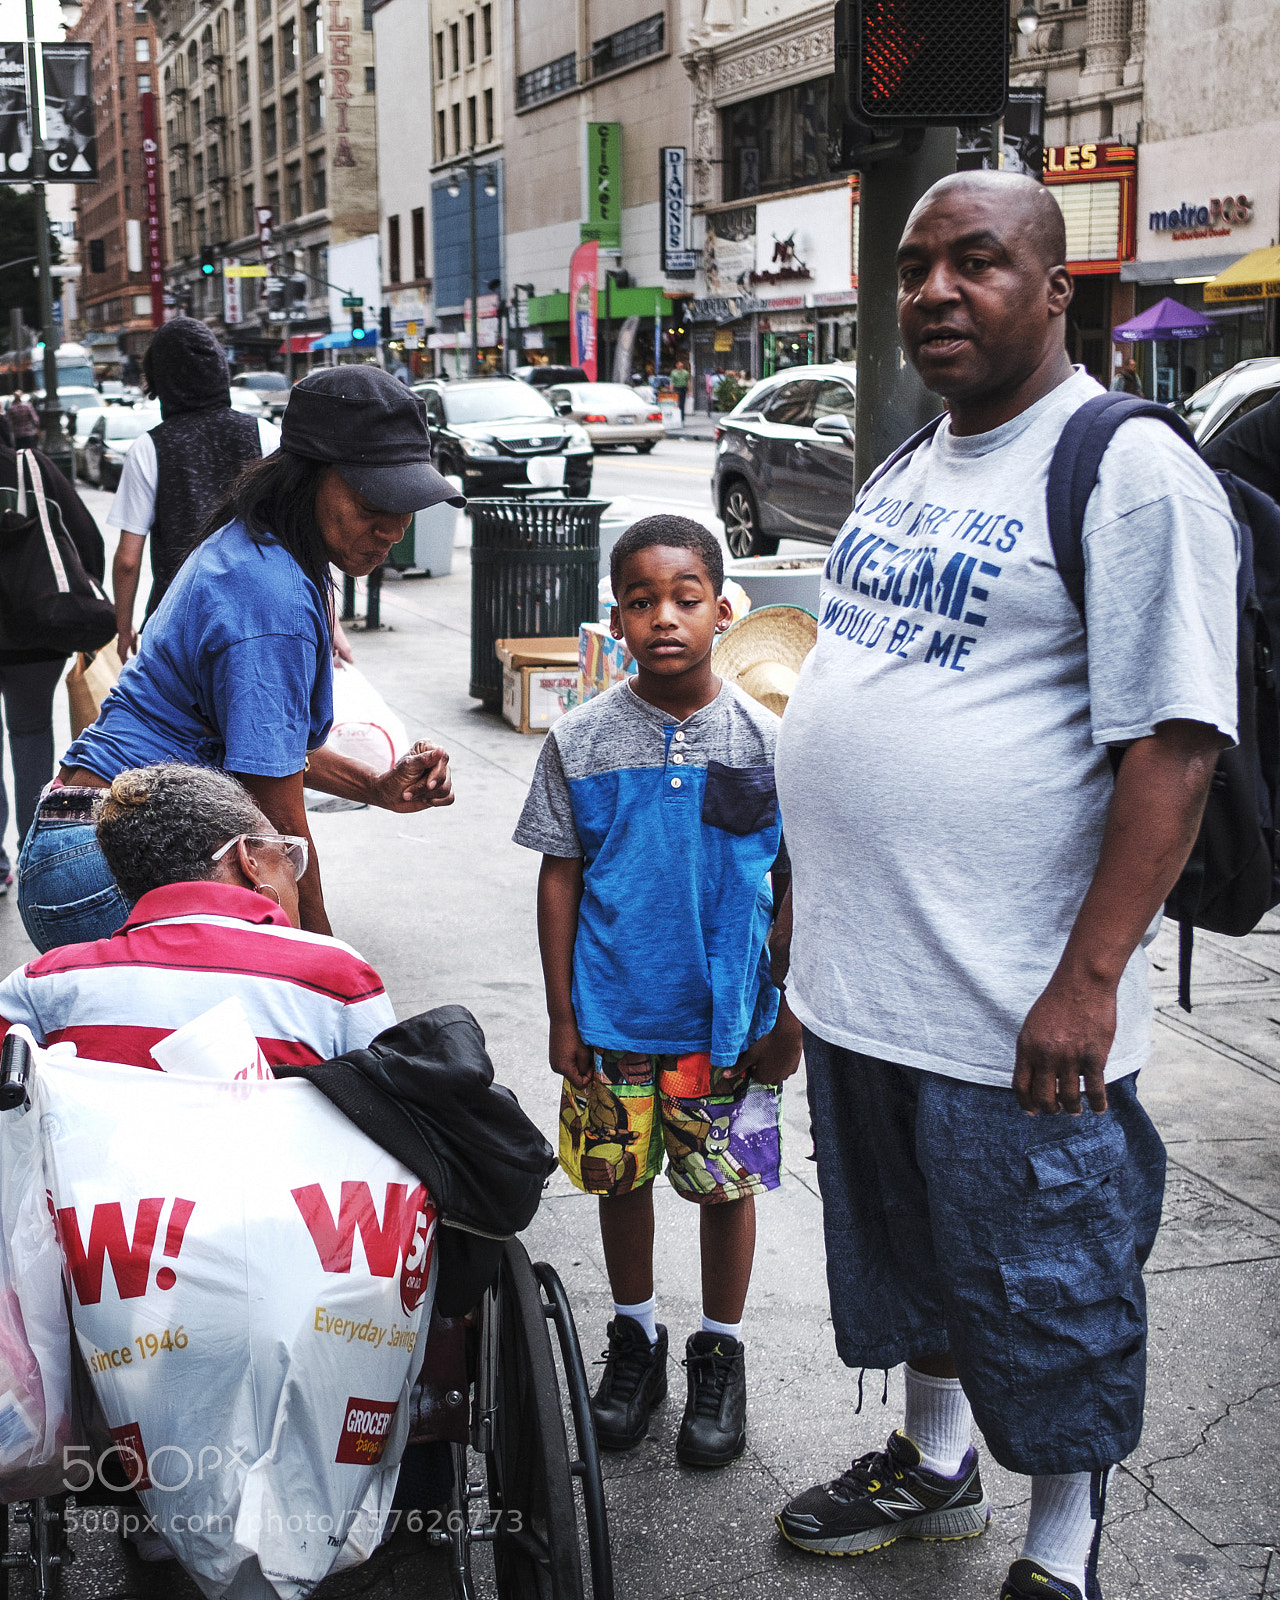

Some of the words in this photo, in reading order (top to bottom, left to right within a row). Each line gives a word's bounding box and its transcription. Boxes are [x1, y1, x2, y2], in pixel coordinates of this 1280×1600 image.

[668, 151, 683, 248] DIAMONDS
[1149, 194, 1253, 231] metroPCS
[863, 496, 914, 529] YOU
[951, 508, 1024, 553] THIS
[819, 595, 890, 649] WOULD
[885, 618, 924, 659] BE
[924, 629, 977, 672] ME
[91, 1345, 133, 1374] since
[134, 1324, 189, 1360] 1946
[313, 1306, 388, 1349] Everyday
[1031, 1572, 1049, 1584] new
